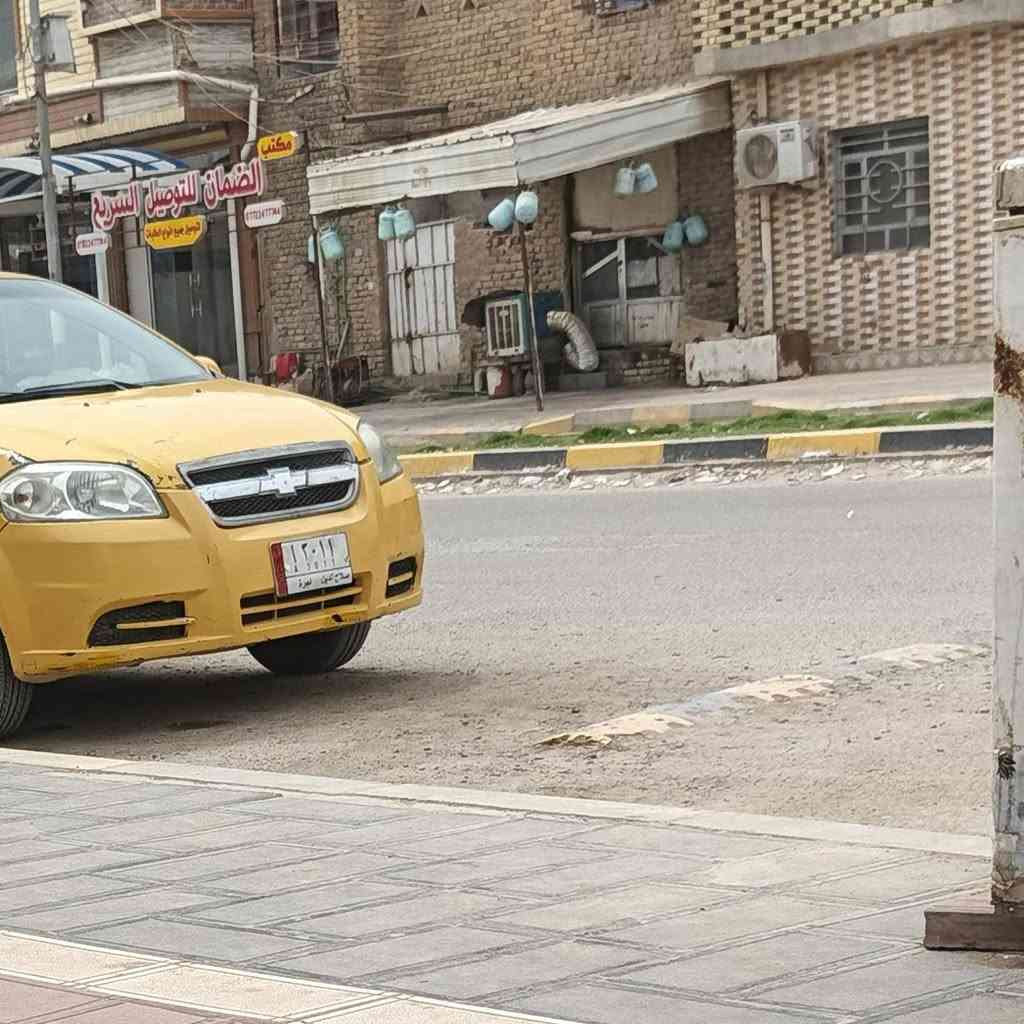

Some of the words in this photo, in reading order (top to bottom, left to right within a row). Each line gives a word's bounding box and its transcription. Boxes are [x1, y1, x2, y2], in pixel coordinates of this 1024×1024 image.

[261, 136, 292, 159] مكتب
[92, 181, 140, 228] السريع
[145, 172, 198, 215] للتوصيل
[205, 159, 262, 207] الضمان
